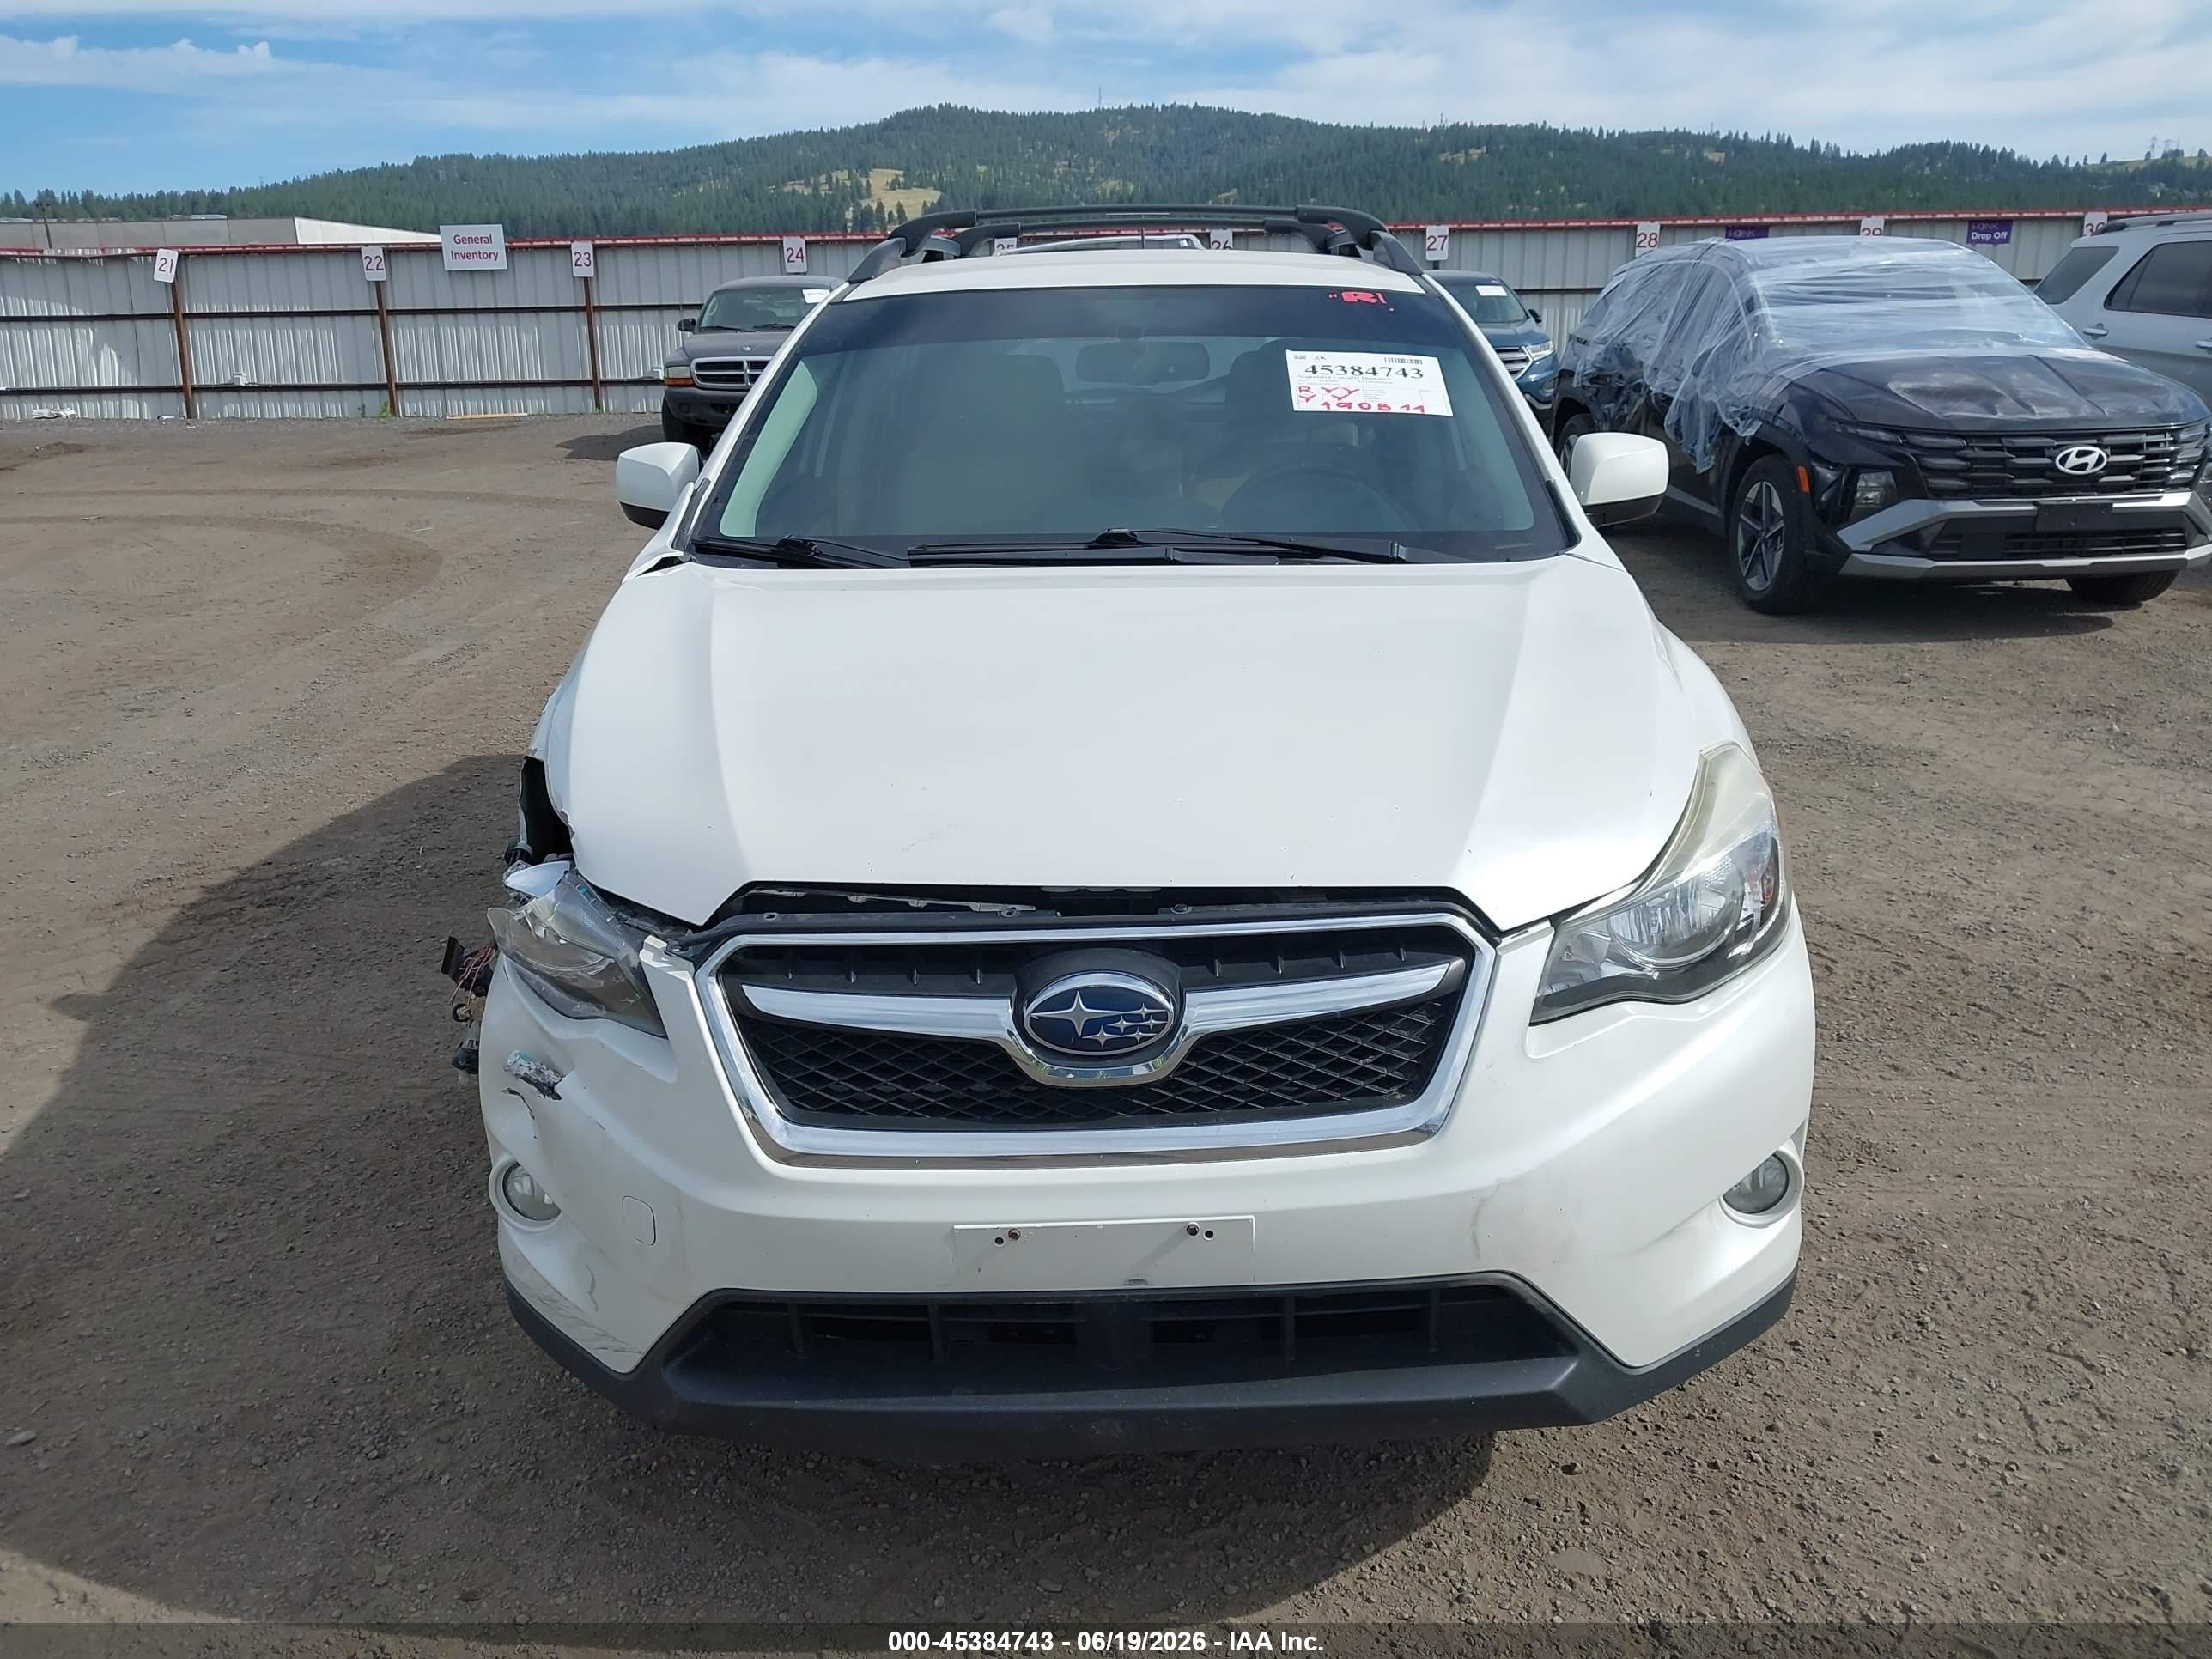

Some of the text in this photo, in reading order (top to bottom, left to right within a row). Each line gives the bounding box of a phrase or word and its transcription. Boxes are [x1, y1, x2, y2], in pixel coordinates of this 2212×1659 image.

[453, 234, 493, 245] General
[1426, 234, 1449, 251] 27
[1636, 232, 1658, 248] 28
[1971, 231, 2008, 241] Drop Off
[451, 250, 499, 262] Inventory
[574, 251, 592, 267] 23
[786, 246, 805, 263] 24
[158, 257, 173, 274] 21
[364, 255, 385, 271] 22
[1304, 364, 1424, 380] 45384743
